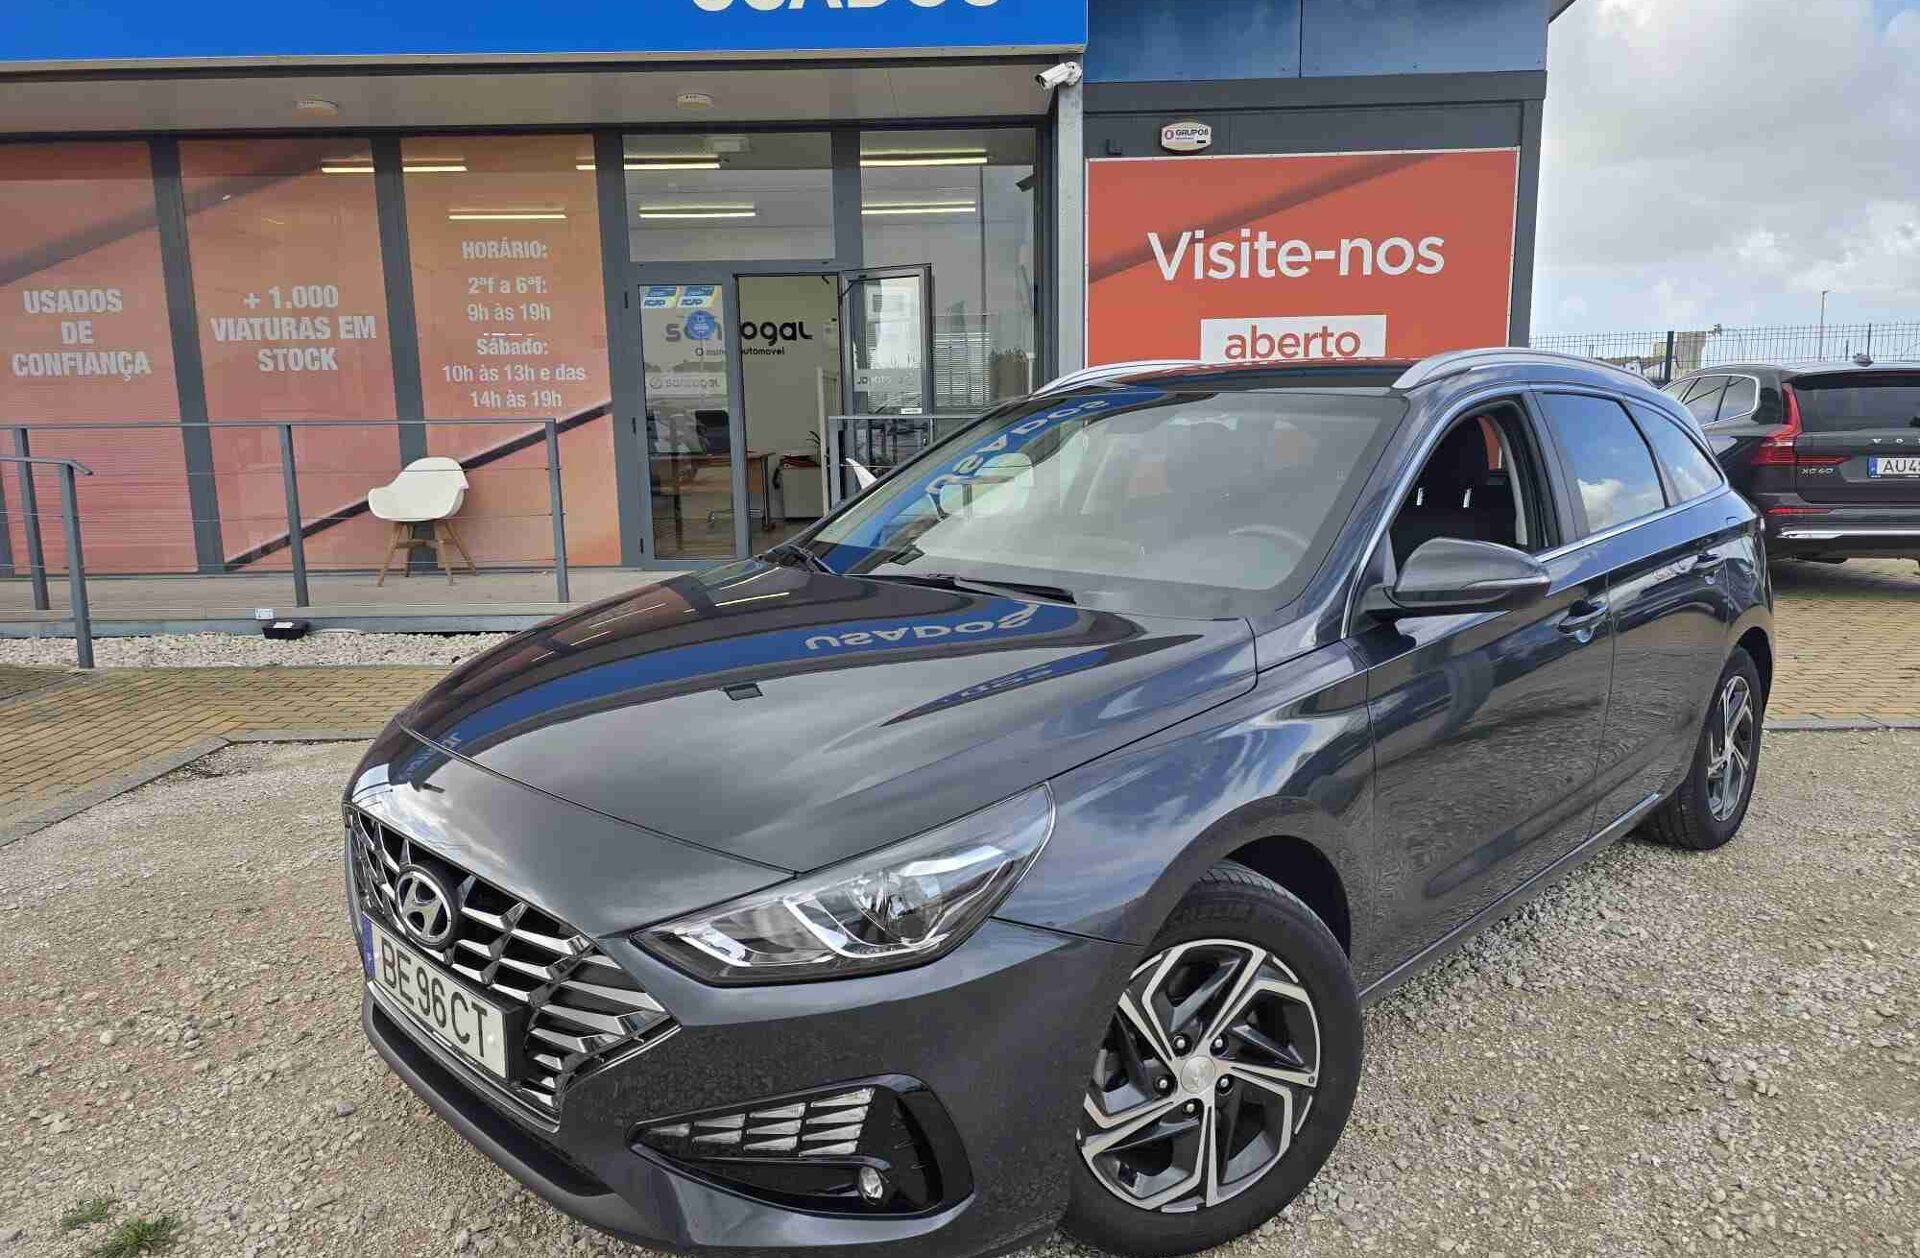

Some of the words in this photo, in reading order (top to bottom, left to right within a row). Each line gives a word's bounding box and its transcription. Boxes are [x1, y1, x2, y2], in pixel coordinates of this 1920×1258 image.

[462, 237, 548, 259] HORÁRIO:
[1147, 228, 1445, 281] Visite-nos
[243, 293, 261, 309] +
[268, 285, 339, 309] 1.000
[500, 279, 511, 294] a
[23, 288, 123, 314] USADOS
[467, 303, 489, 321] 9h
[494, 302, 515, 321] às
[520, 303, 551, 321] 19h
[61, 320, 94, 344] DE
[210, 316, 331, 342] VIATURAS
[338, 315, 377, 339] EM
[476, 336, 549, 355] Sábado:
[1224, 324, 1361, 360] aberto
[12, 351, 152, 381] CONFIANÇA
[258, 348, 339, 372] STOCK
[442, 365, 474, 382] 10h
[479, 364, 499, 381] às
[504, 364, 535, 381] 13h
[540, 368, 550, 381] e
[555, 364, 586, 381] das
[470, 390, 500, 408] 14h
[506, 389, 526, 408] às
[531, 391, 562, 408] 19h
